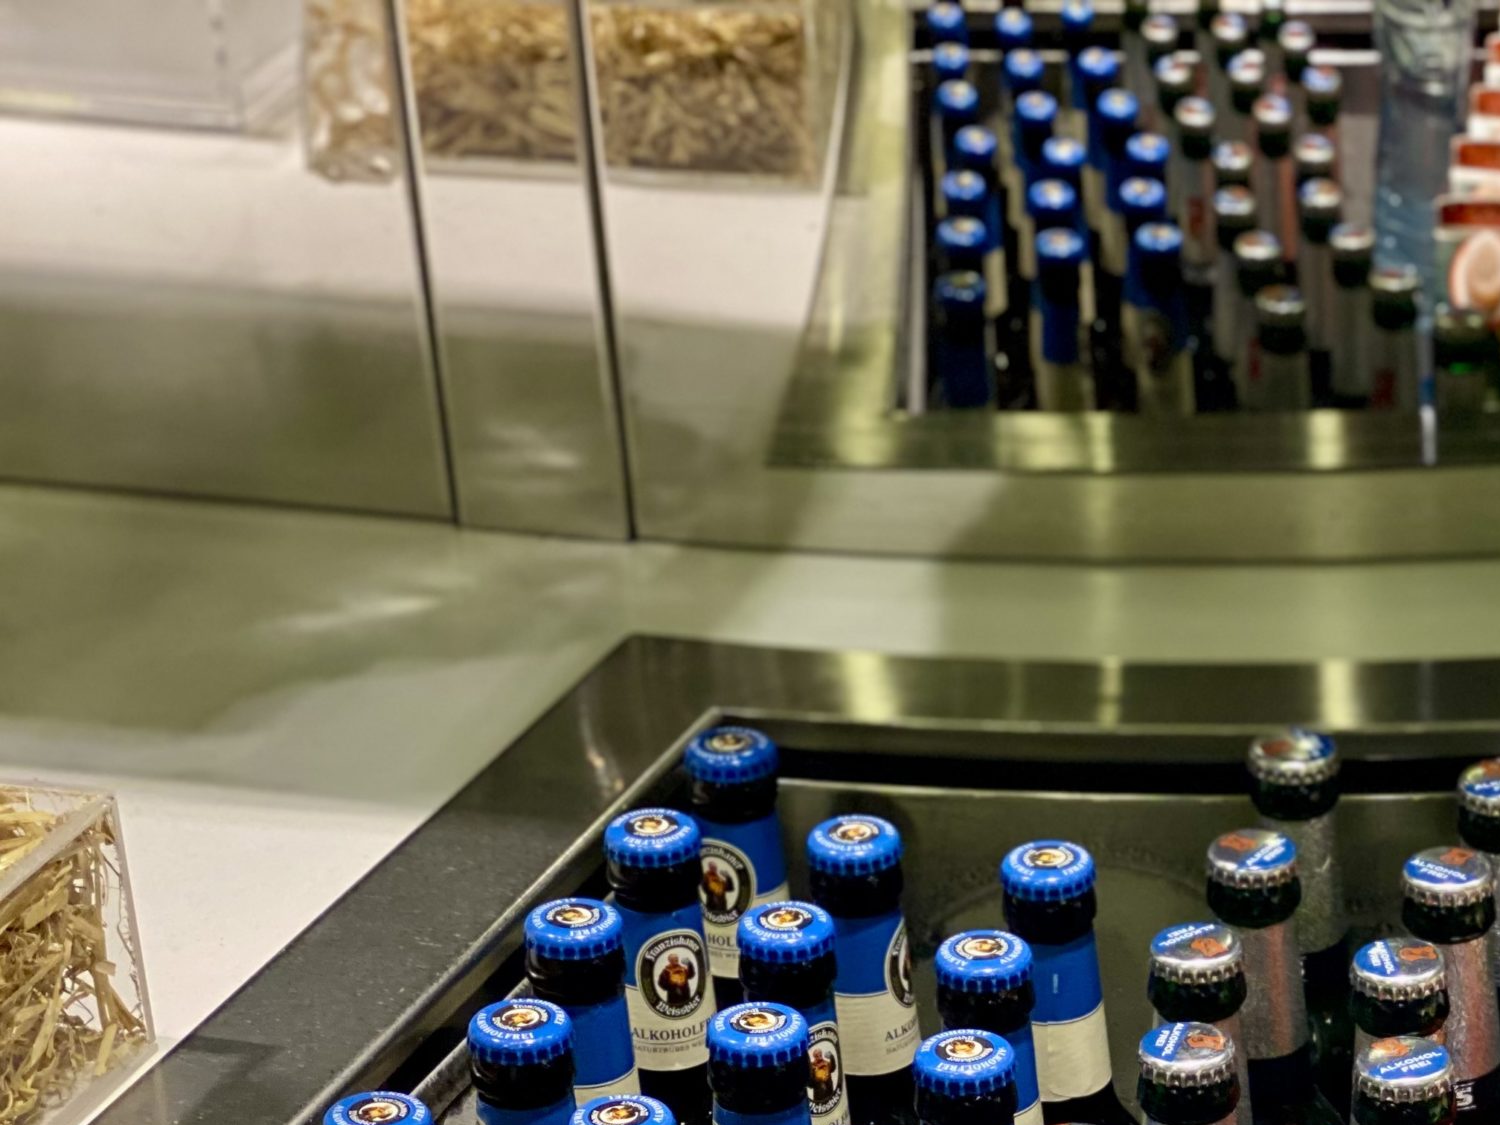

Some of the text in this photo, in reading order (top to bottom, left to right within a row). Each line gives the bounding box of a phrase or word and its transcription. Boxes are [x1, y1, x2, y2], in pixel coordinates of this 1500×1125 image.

[1409, 858, 1466, 881] ALKOHOL
[476, 1012, 534, 1039] ALKOHOLFREI
[632, 1023, 706, 1042] ALKOHOLF
[1155, 1030, 1170, 1046] FREI
[1162, 1022, 1185, 1056] ALKOHOL
[1380, 1050, 1442, 1074] ALKOHOL
[1401, 1060, 1432, 1072] FREI
